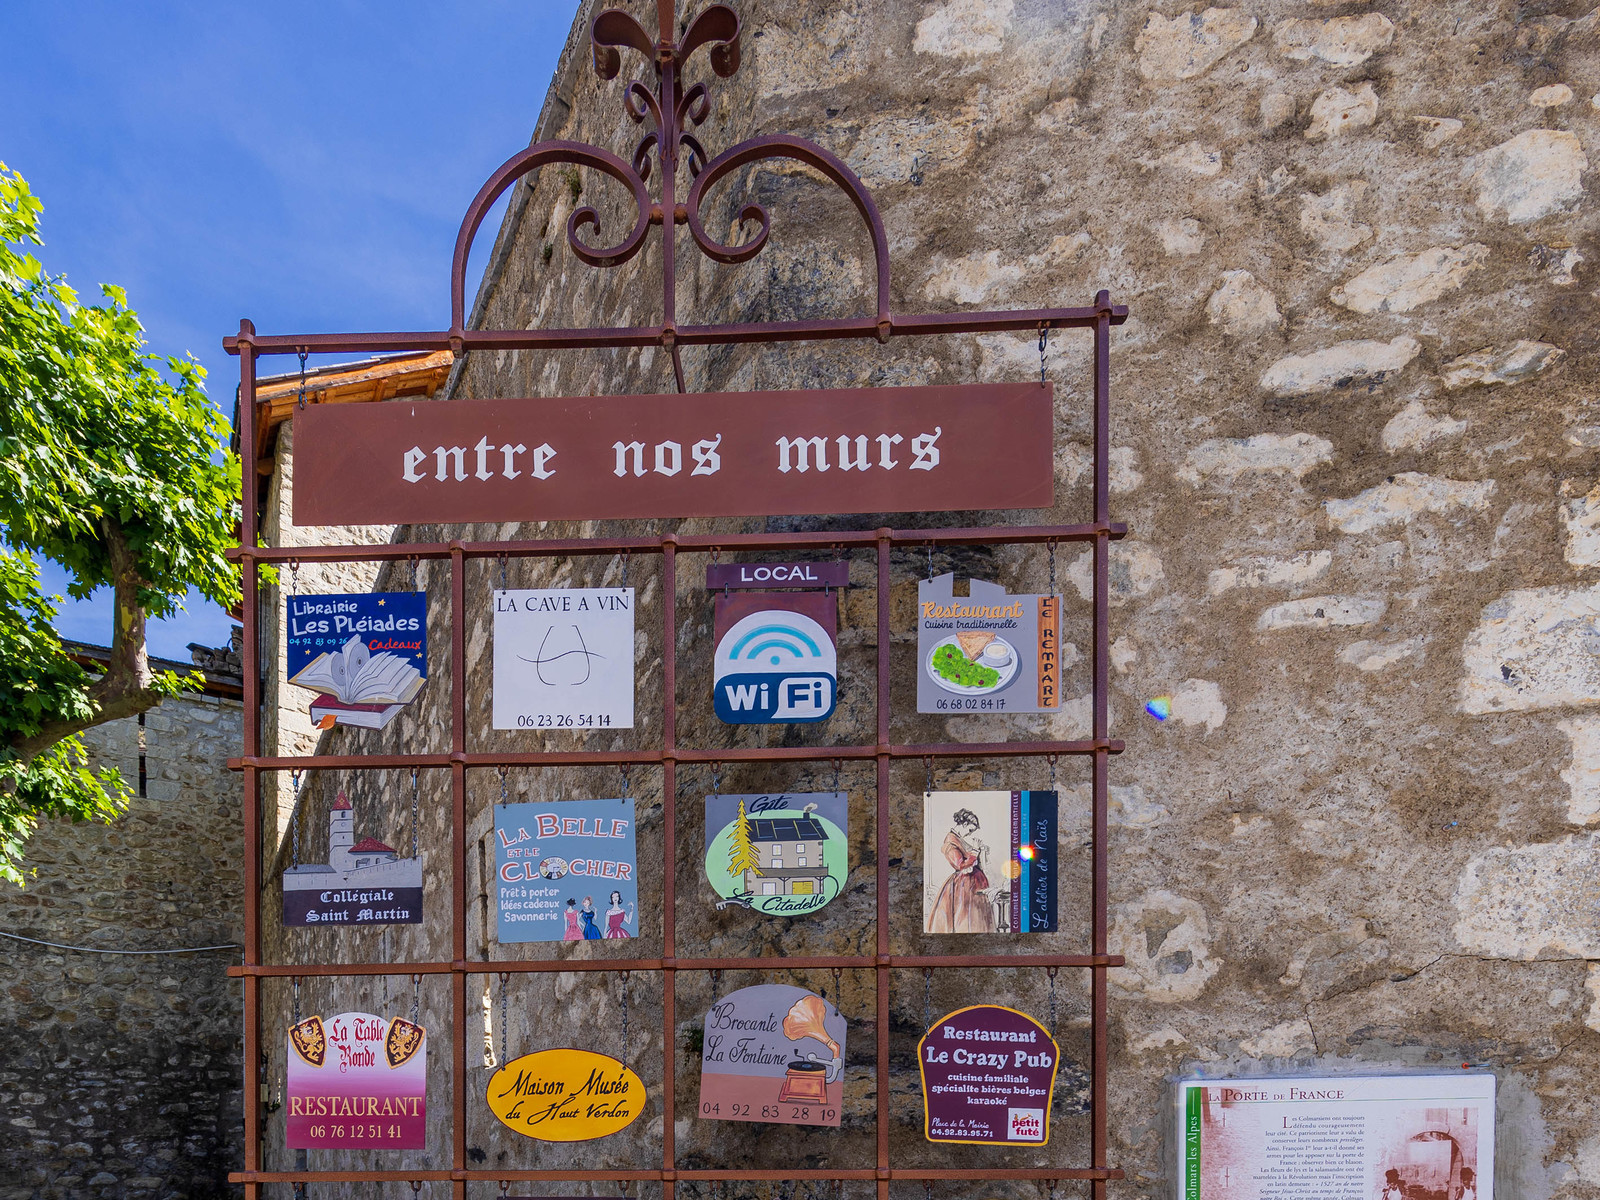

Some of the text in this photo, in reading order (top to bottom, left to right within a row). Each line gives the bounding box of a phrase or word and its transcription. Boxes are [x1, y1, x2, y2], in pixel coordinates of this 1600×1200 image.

[402, 427, 941, 483] entre nos murs
[741, 566, 818, 581] LOCAL
[293, 600, 358, 616] Librairie
[497, 596, 629, 612] LA CAVE A VIN
[921, 601, 1024, 619] Restaurant
[292, 614, 420, 636] Les Pléiades
[924, 619, 1018, 629] Cuisine traditionnelle
[368, 638, 422, 650] Cadeaux
[936, 699, 1006, 709] 06 68 02 84 17
[517, 715, 611, 727] 06 23 26 54 14
[749, 795, 792, 816] Gîte
[1034, 819, 1048, 850] Naïs
[507, 848, 540, 858] ET LE
[1037, 859, 1048, 872] de
[320, 889, 394, 904] Collégiale
[501, 886, 560, 900] Prêt à porter
[501, 899, 560, 910] Idées cadeaux
[762, 894, 826, 911] Citadelle
[306, 907, 410, 922] Saint Martin
[504, 911, 558, 922] Savonnerie
[711, 1003, 777, 1032] Brocante
[329, 1018, 384, 1047] La Table
[944, 1026, 1036, 1043] Restaurant
[705, 1035, 787, 1065] La Fontaine
[926, 1046, 1052, 1069] Le Crazy Pub
[338, 1044, 375, 1073] Ronde
[498, 1068, 629, 1097] Maison Musée
[948, 1073, 1029, 1083] cuisine familiale
[981, 1085, 1011, 1094] bières
[1013, 1086, 1046, 1096] belges
[290, 1096, 422, 1116] RESTAURANT
[967, 1096, 1007, 1105] karaoké
[505, 1097, 629, 1125] du Haut Verdon
[703, 1102, 836, 1121] 04 92 83 28 19
[1012, 1118, 1040, 1128] petit
[1188, 1116, 1200, 1144] Alpes
[310, 1125, 401, 1137] 06 76 12 51 41
[1016, 1127, 1039, 1136] futé
[1187, 1147, 1197, 1160] les
